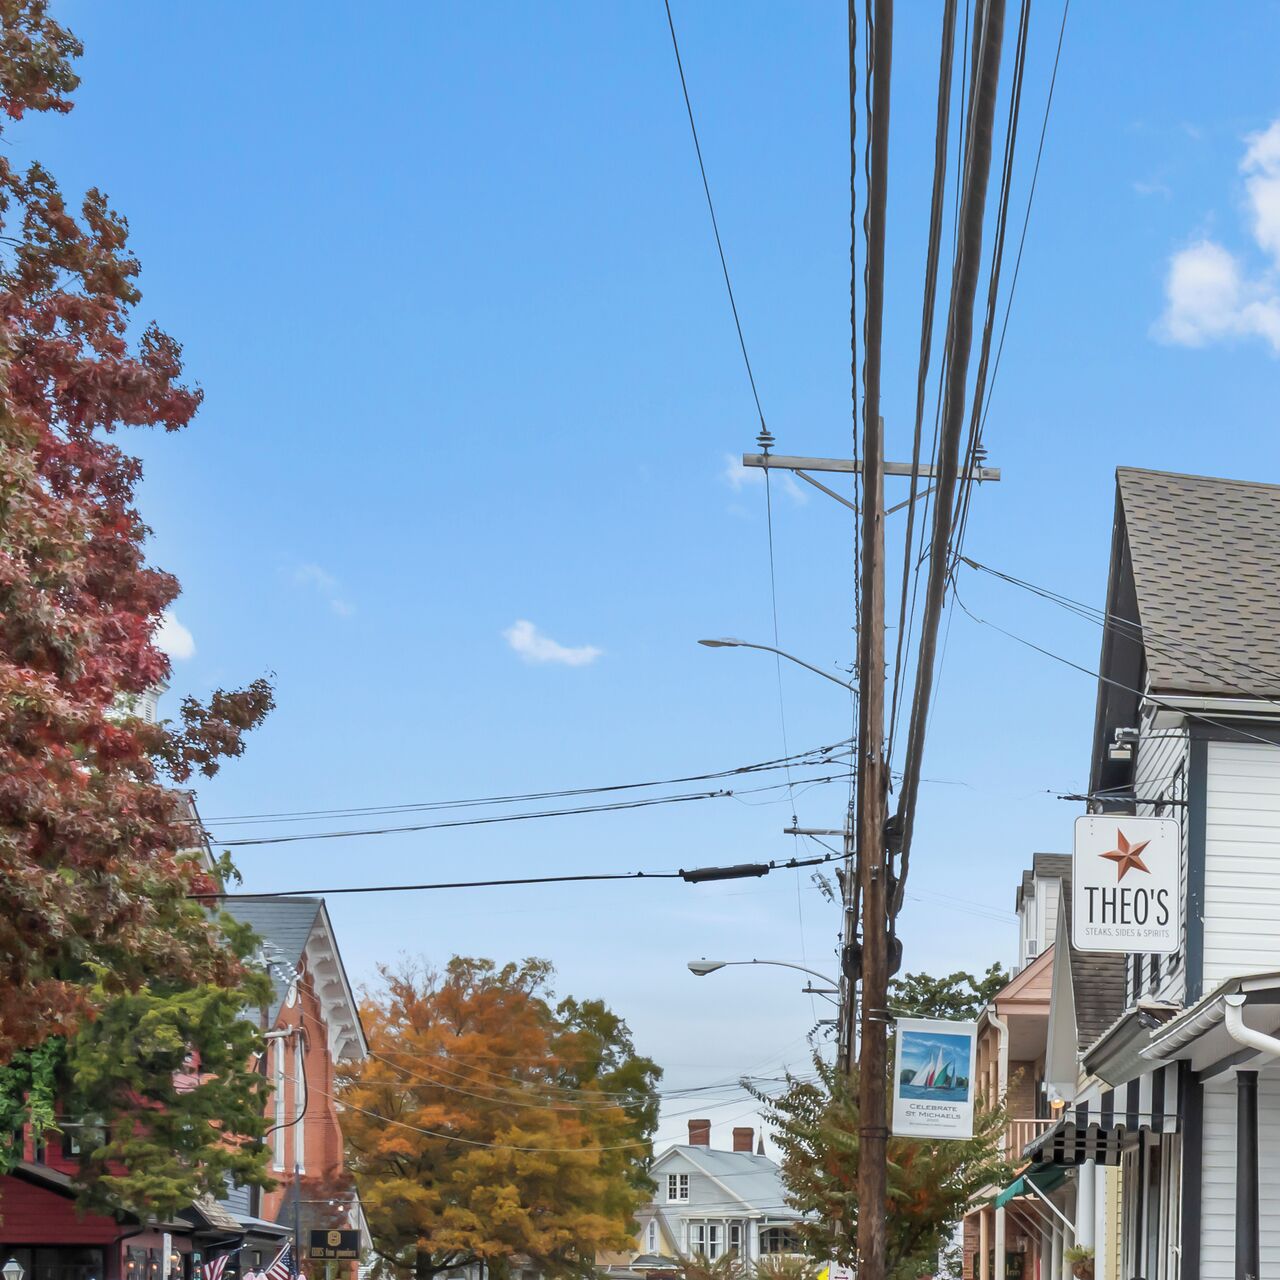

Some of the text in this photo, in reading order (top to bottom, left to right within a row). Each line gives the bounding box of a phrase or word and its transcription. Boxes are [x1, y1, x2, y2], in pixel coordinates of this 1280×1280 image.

[1083, 886, 1169, 926] THEO'S
[1115, 928, 1135, 938] SIDES
[1143, 929, 1170, 939] SPIRITS
[909, 1103, 958, 1112] CELEBRATE
[918, 1111, 961, 1120] MICHAELS
